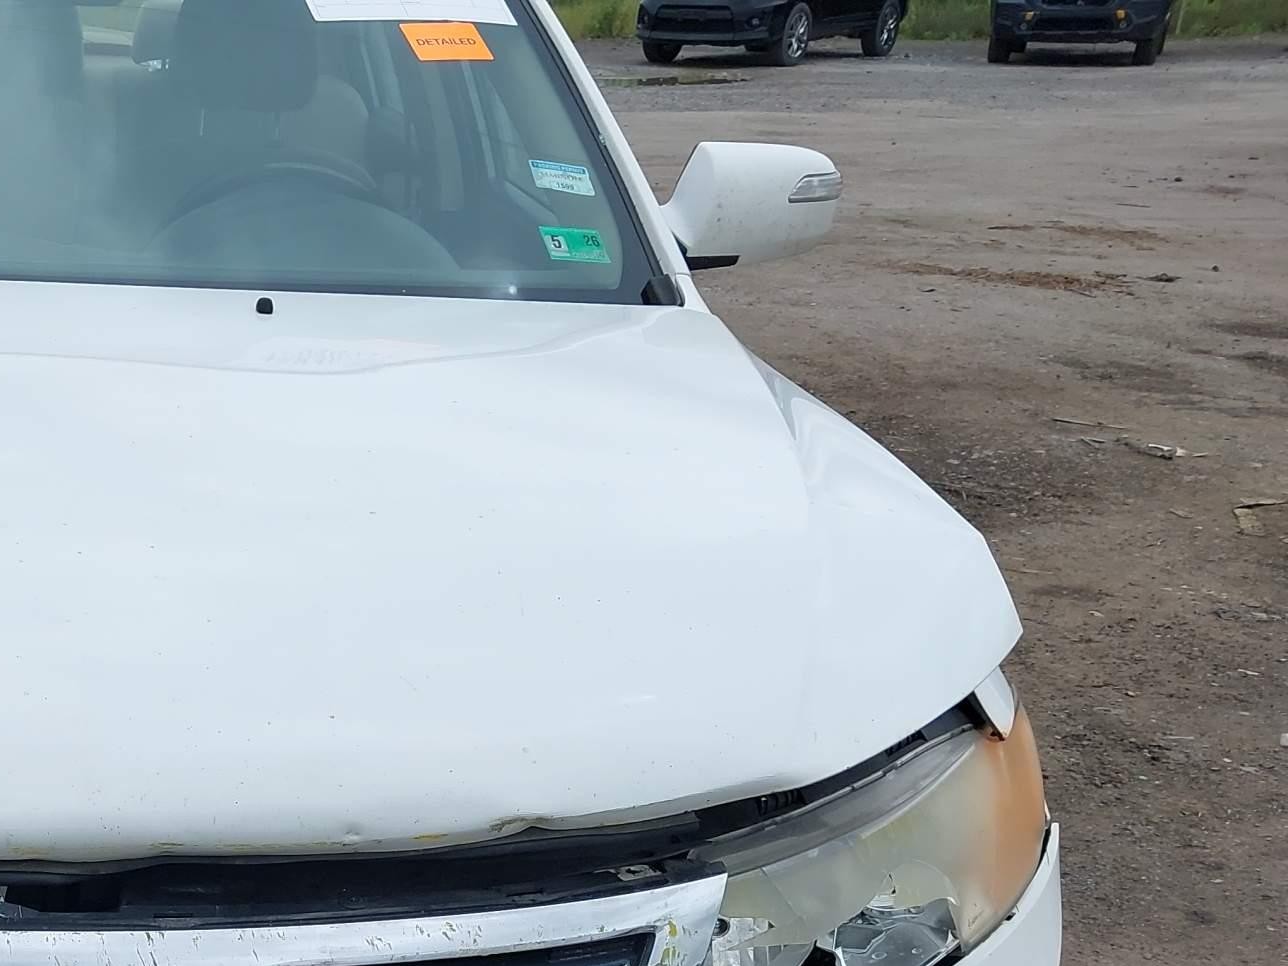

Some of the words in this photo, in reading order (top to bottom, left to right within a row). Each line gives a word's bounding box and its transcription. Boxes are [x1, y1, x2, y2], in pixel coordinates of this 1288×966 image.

[415, 37, 477, 46] DETAILED
[551, 235, 562, 249] 5
[583, 235, 600, 247] 26
